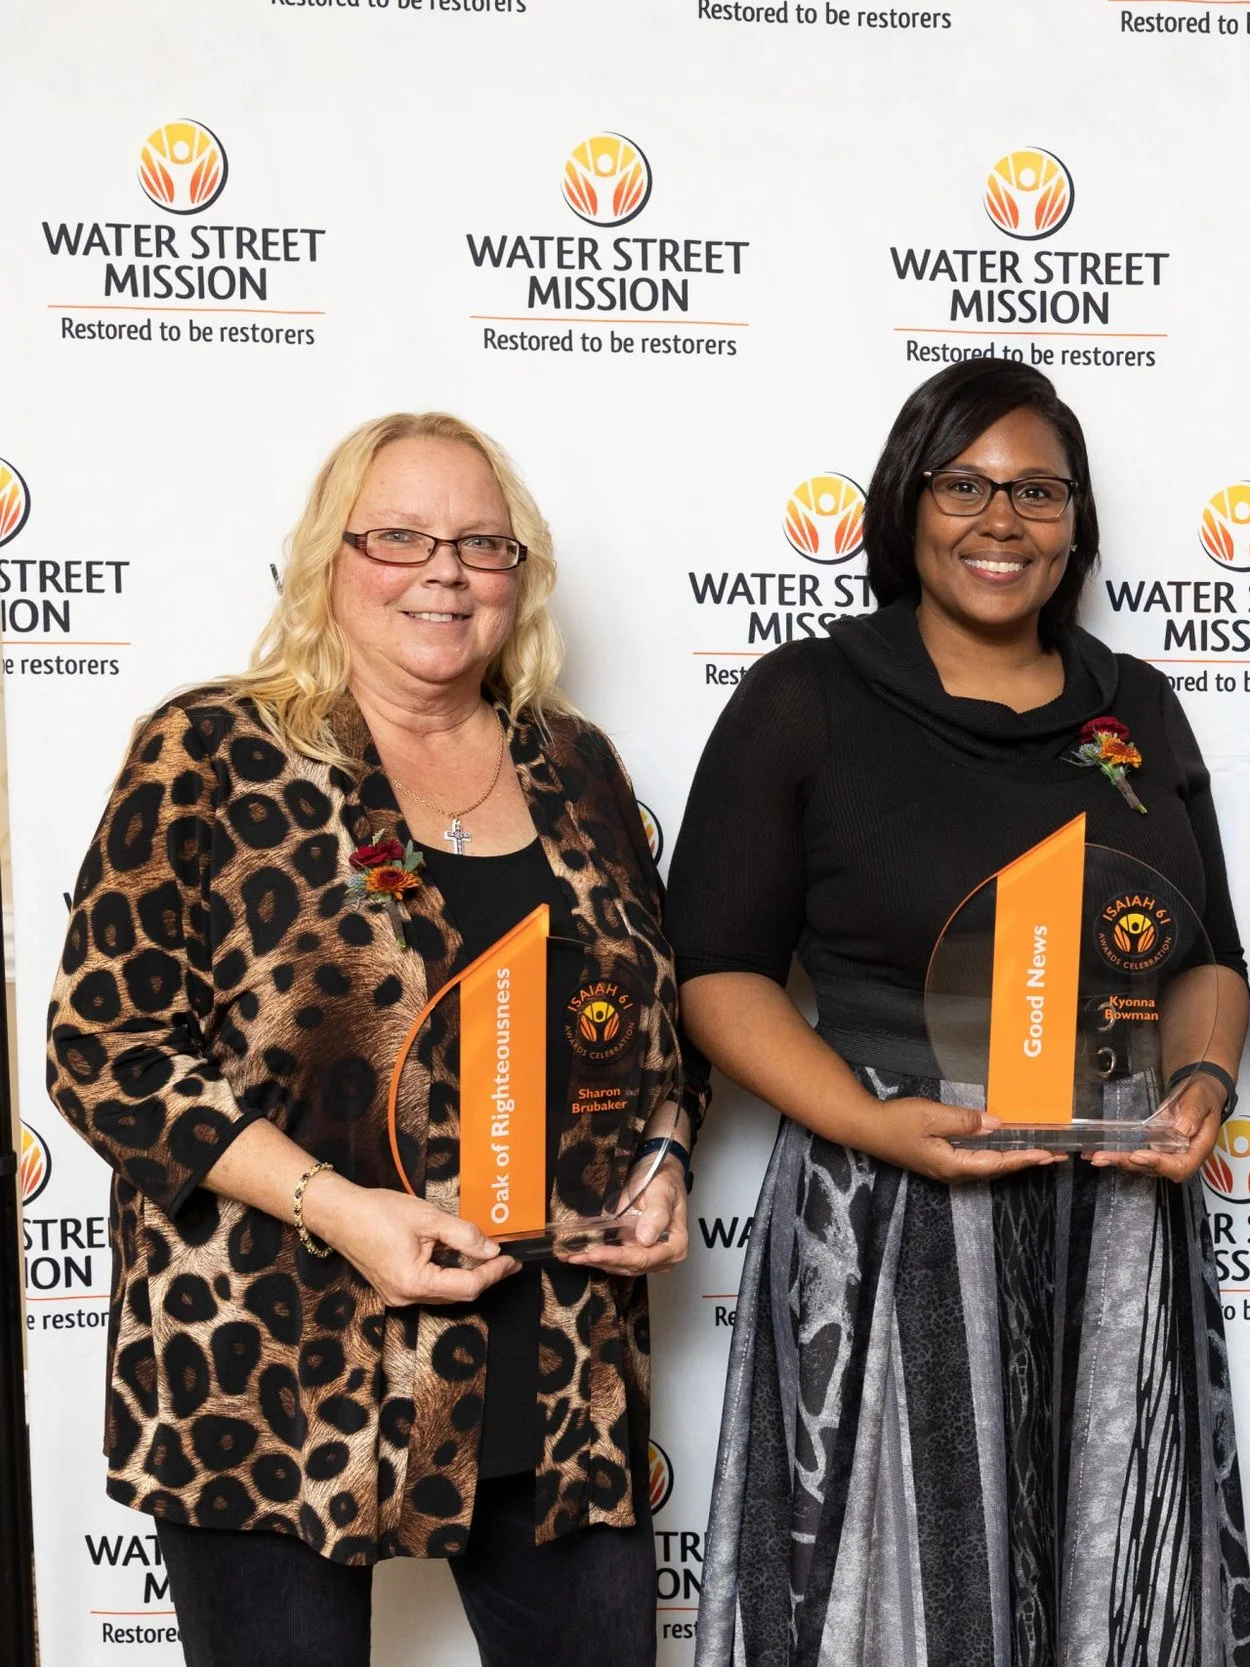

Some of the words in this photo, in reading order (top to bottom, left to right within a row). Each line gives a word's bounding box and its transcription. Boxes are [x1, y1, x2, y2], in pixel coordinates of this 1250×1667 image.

[698, 0, 789, 24] Restored
[796, 4, 817, 24] to
[825, 2, 850, 25] be
[857, 9, 952, 29] restorers
[1121, 10, 1211, 34] Restored
[1217, 15, 1239, 35] to
[41, 221, 180, 259] WATER
[190, 225, 326, 262] STREET
[465, 233, 602, 271] WATER
[612, 237, 750, 275] STREET
[889, 246, 1023, 284] WATER
[1033, 250, 1170, 286] STREET
[104, 263, 267, 301] MISSION
[527, 275, 689, 312] MISSION
[950, 288, 1109, 325] MISSION
[61, 317, 152, 341] Restored
[159, 321, 181, 342] to
[189, 319, 213, 343] be
[220, 323, 315, 345] restorers
[483, 327, 574, 352] Restored
[580, 332, 603, 353] to
[610, 330, 635, 354] be
[641, 334, 737, 356] restorers
[1031, 343, 1054, 365] be
[1061, 346, 1156, 367] restorers
[0, 559, 130, 594] STREET
[688, 572, 823, 607] WATER
[1104, 579, 1238, 614] WATER
[21, 656, 120, 676] restorers
[705, 664, 746, 685] Rest
[1215, 673, 1237, 693] to
[1102, 895, 1156, 921] ISAIAH
[1156, 908, 1171, 924] 61
[1026, 925, 1048, 988] News
[1098, 932, 1121, 966] AWARDS
[1123, 936, 1172, 970] CELEBRATION
[567, 983, 617, 1012] ISAIAH
[618, 993, 633, 1010] 61
[1109, 995, 1156, 1008] Kyonna
[1023, 995, 1044, 1058] Good
[1104, 1009, 1159, 1021] Bowman
[491, 968, 515, 1137] Righteousness
[564, 1025, 588, 1058] AWARDS
[589, 1021, 636, 1060] CELEBRATION
[571, 1099, 629, 1114] Brubaker
[578, 1087, 621, 1100] Sharon
[491, 1143, 510, 1167] of
[491, 1175, 509, 1224] Oak
[43, 1309, 109, 1331] restor
[85, 1535, 165, 1567] WAT
